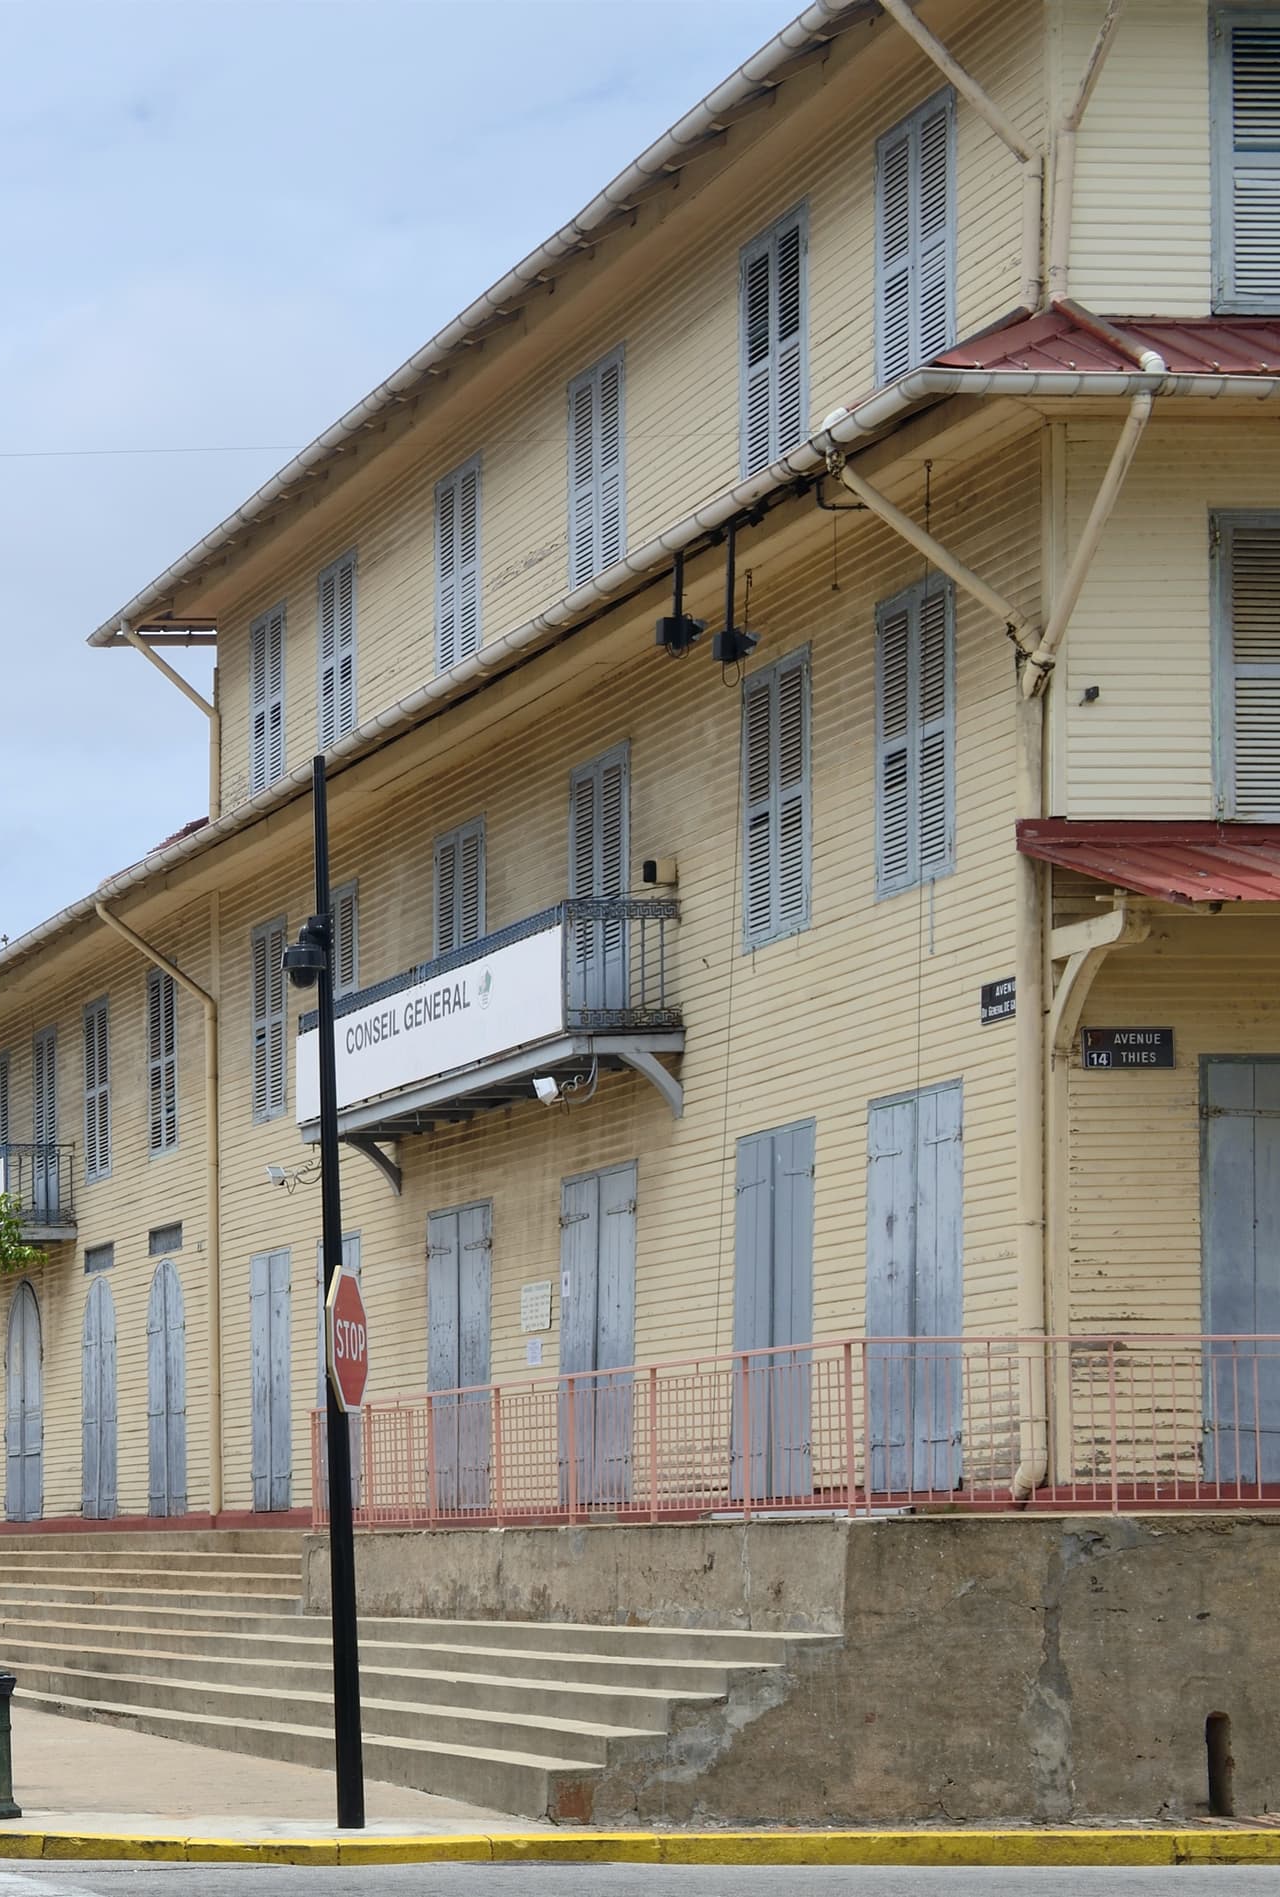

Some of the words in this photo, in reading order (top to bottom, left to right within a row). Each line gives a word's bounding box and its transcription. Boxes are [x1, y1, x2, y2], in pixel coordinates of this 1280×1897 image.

[995, 981, 1015, 996] AVENU
[345, 1008, 400, 1054] CONSEIL
[404, 980, 471, 1031] GENERAL
[1114, 1033, 1161, 1044] AVENUE
[1090, 1053, 1108, 1065] 14
[1120, 1051, 1156, 1063] THIES
[336, 1319, 366, 1362] STOP
